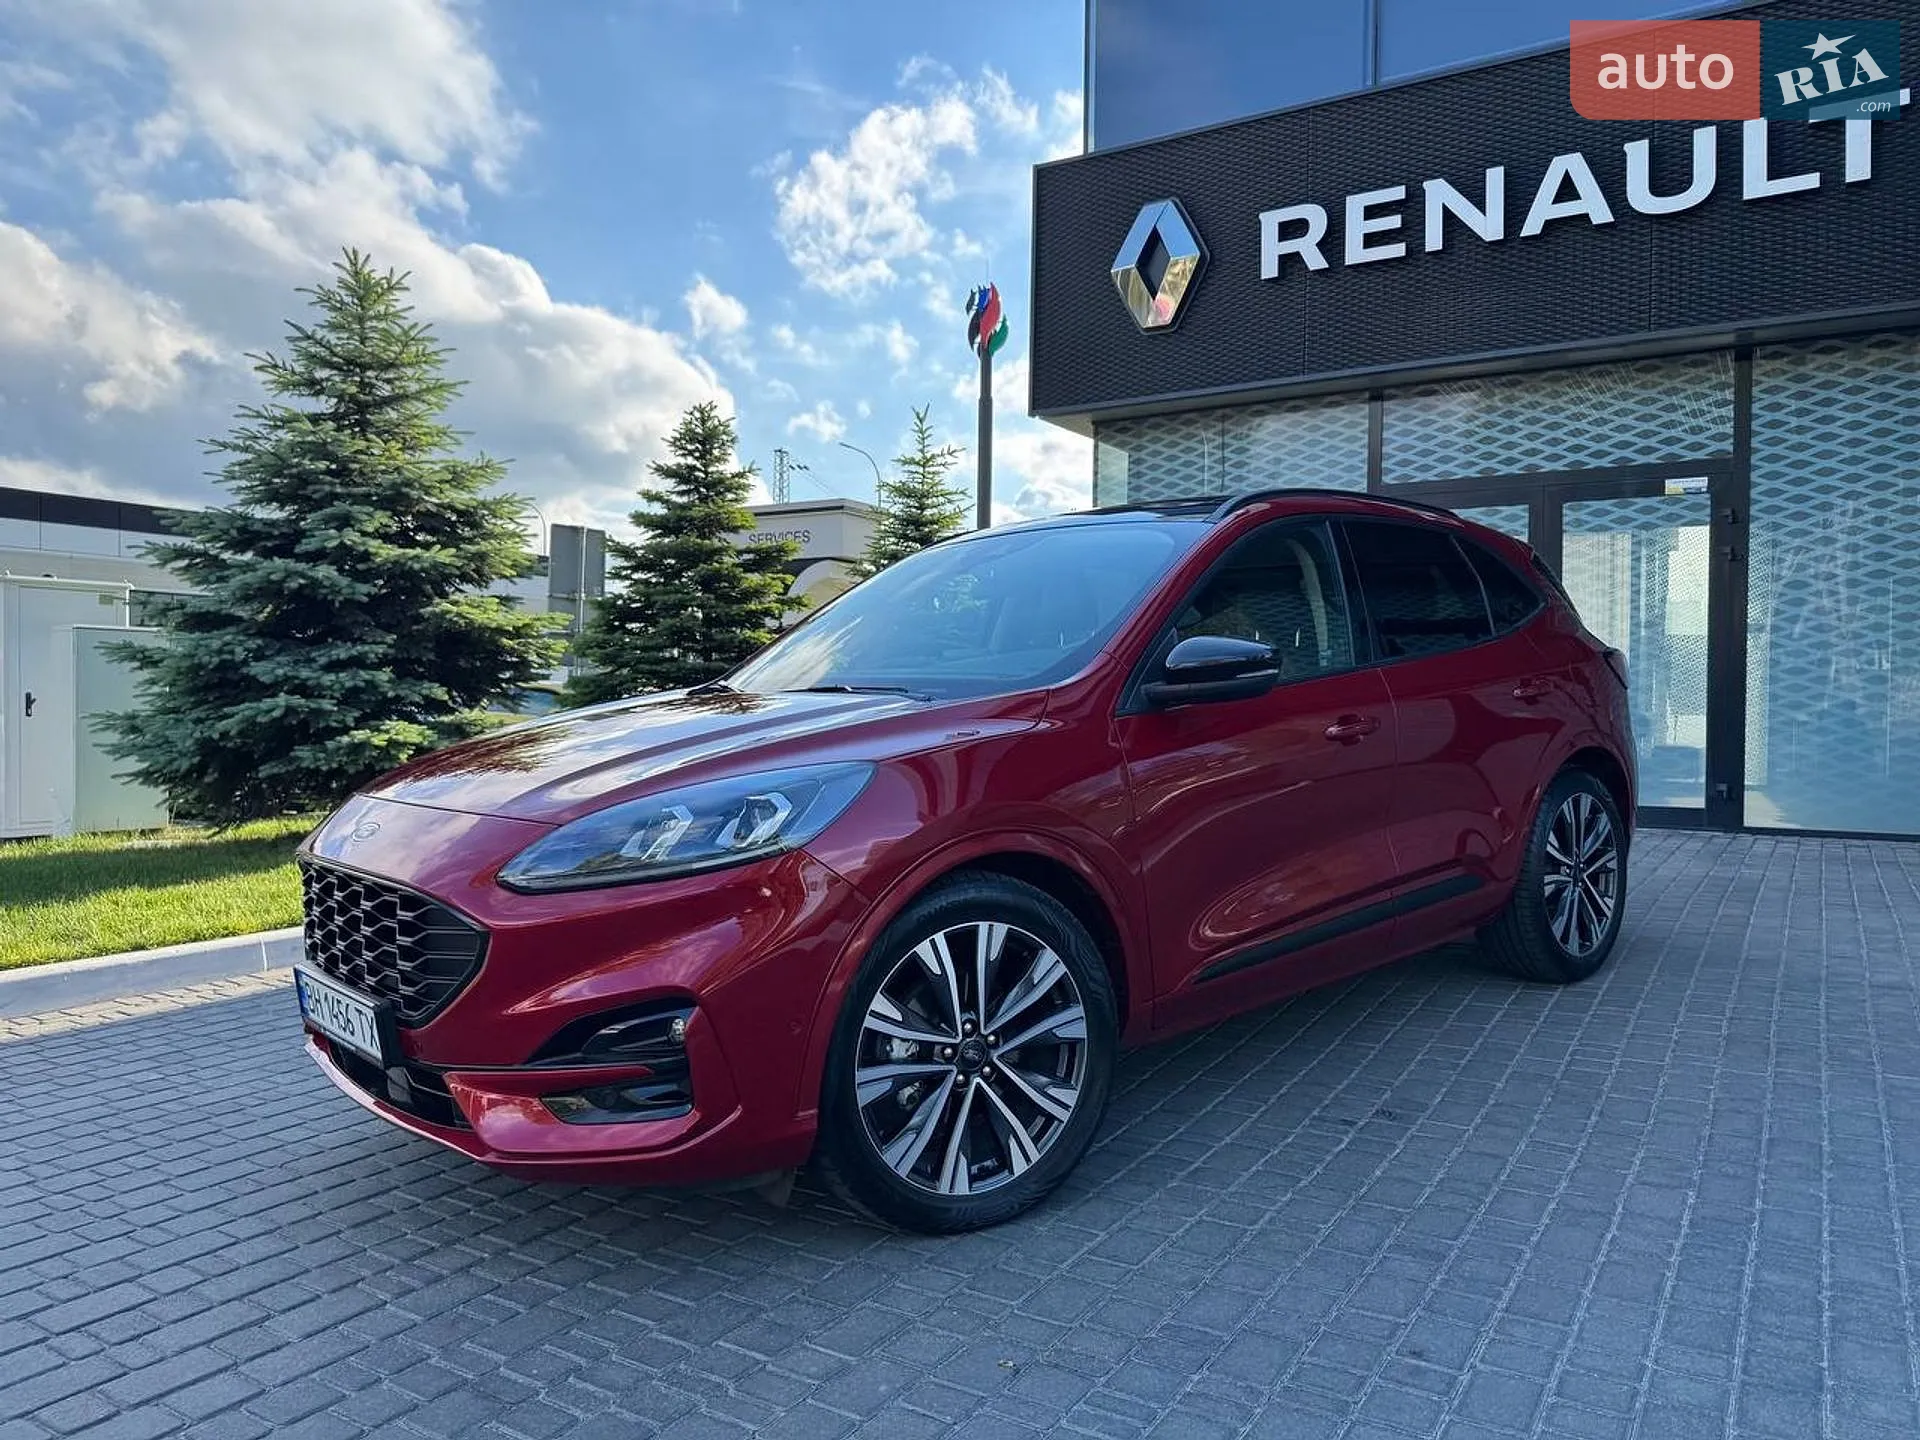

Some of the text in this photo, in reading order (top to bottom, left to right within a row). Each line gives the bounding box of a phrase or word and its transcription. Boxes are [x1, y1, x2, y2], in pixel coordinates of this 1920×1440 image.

[1258, 87, 1911, 280] RENAULT
[748, 529, 811, 545] SERVICES
[324, 992, 355, 1037] 1456
[354, 1006, 380, 1051] TX
